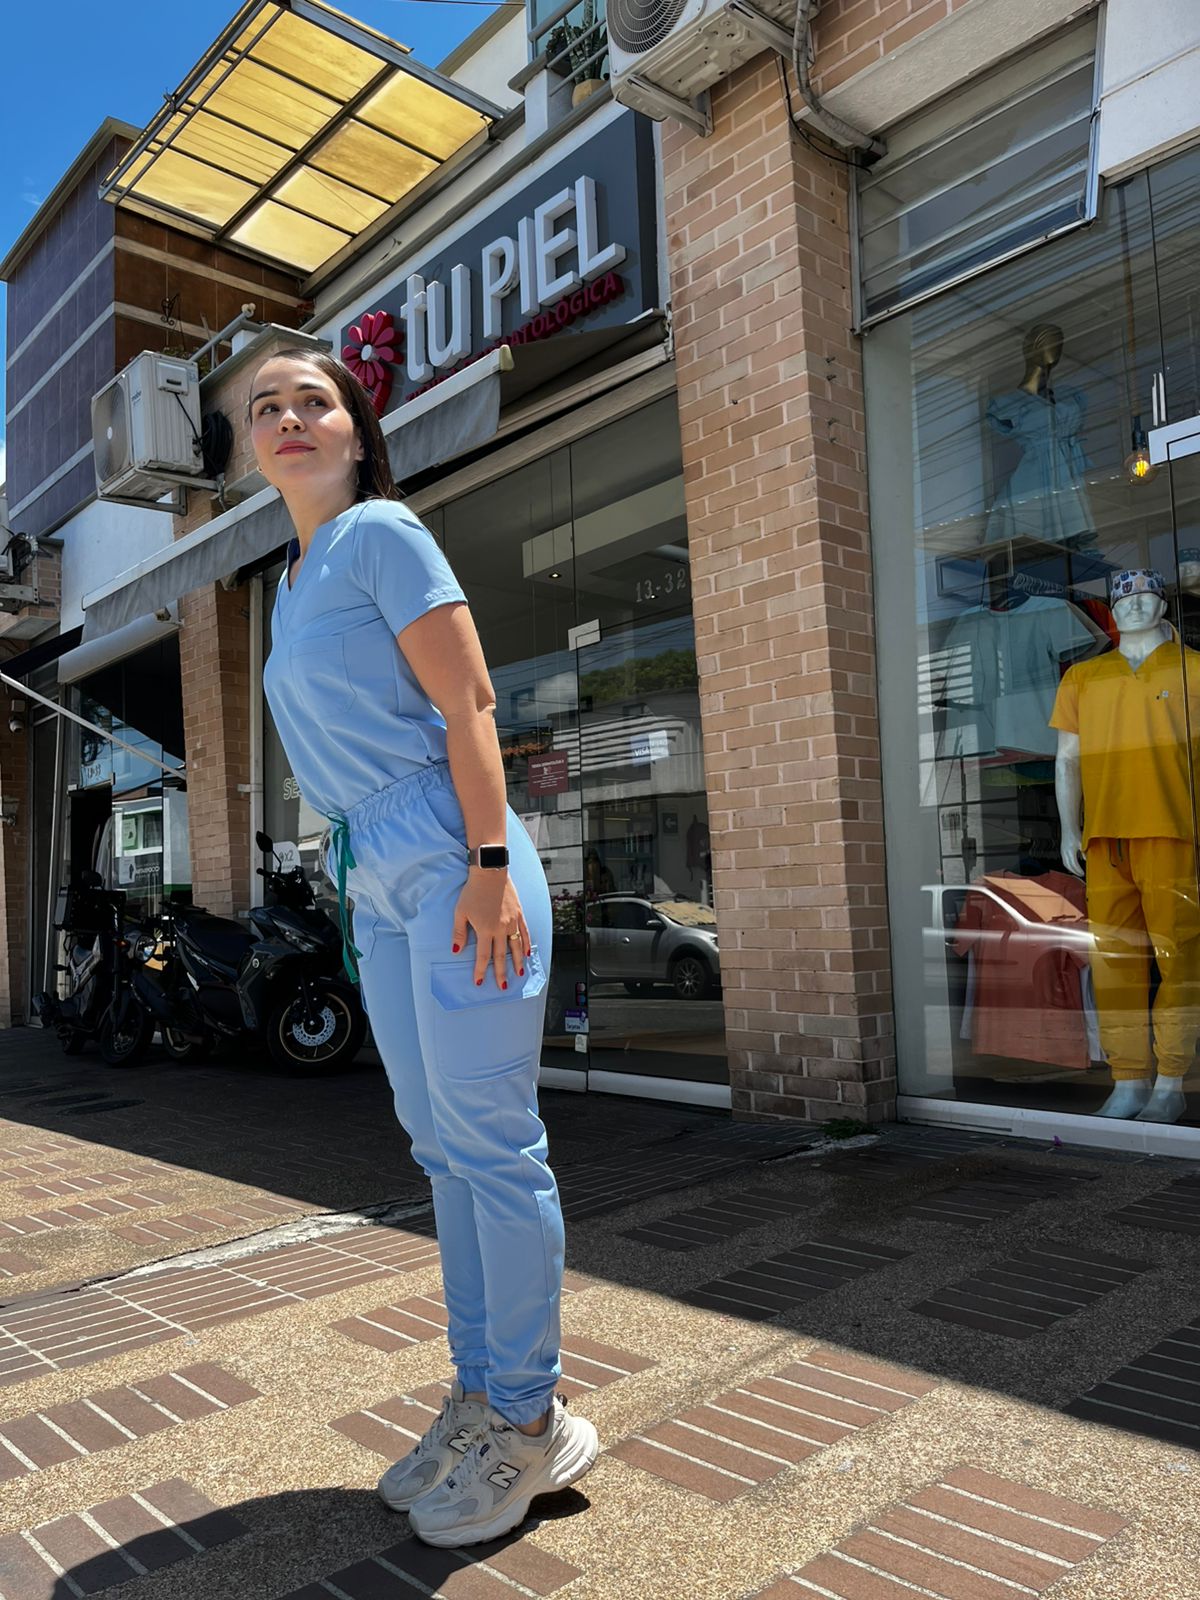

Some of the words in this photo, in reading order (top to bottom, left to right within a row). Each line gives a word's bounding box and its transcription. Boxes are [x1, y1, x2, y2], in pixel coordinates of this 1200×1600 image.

[400, 263, 471, 383] tu
[481, 174, 626, 339] PIEL
[633, 567, 687, 603] 13-32
[487, 1462, 520, 1490] N
